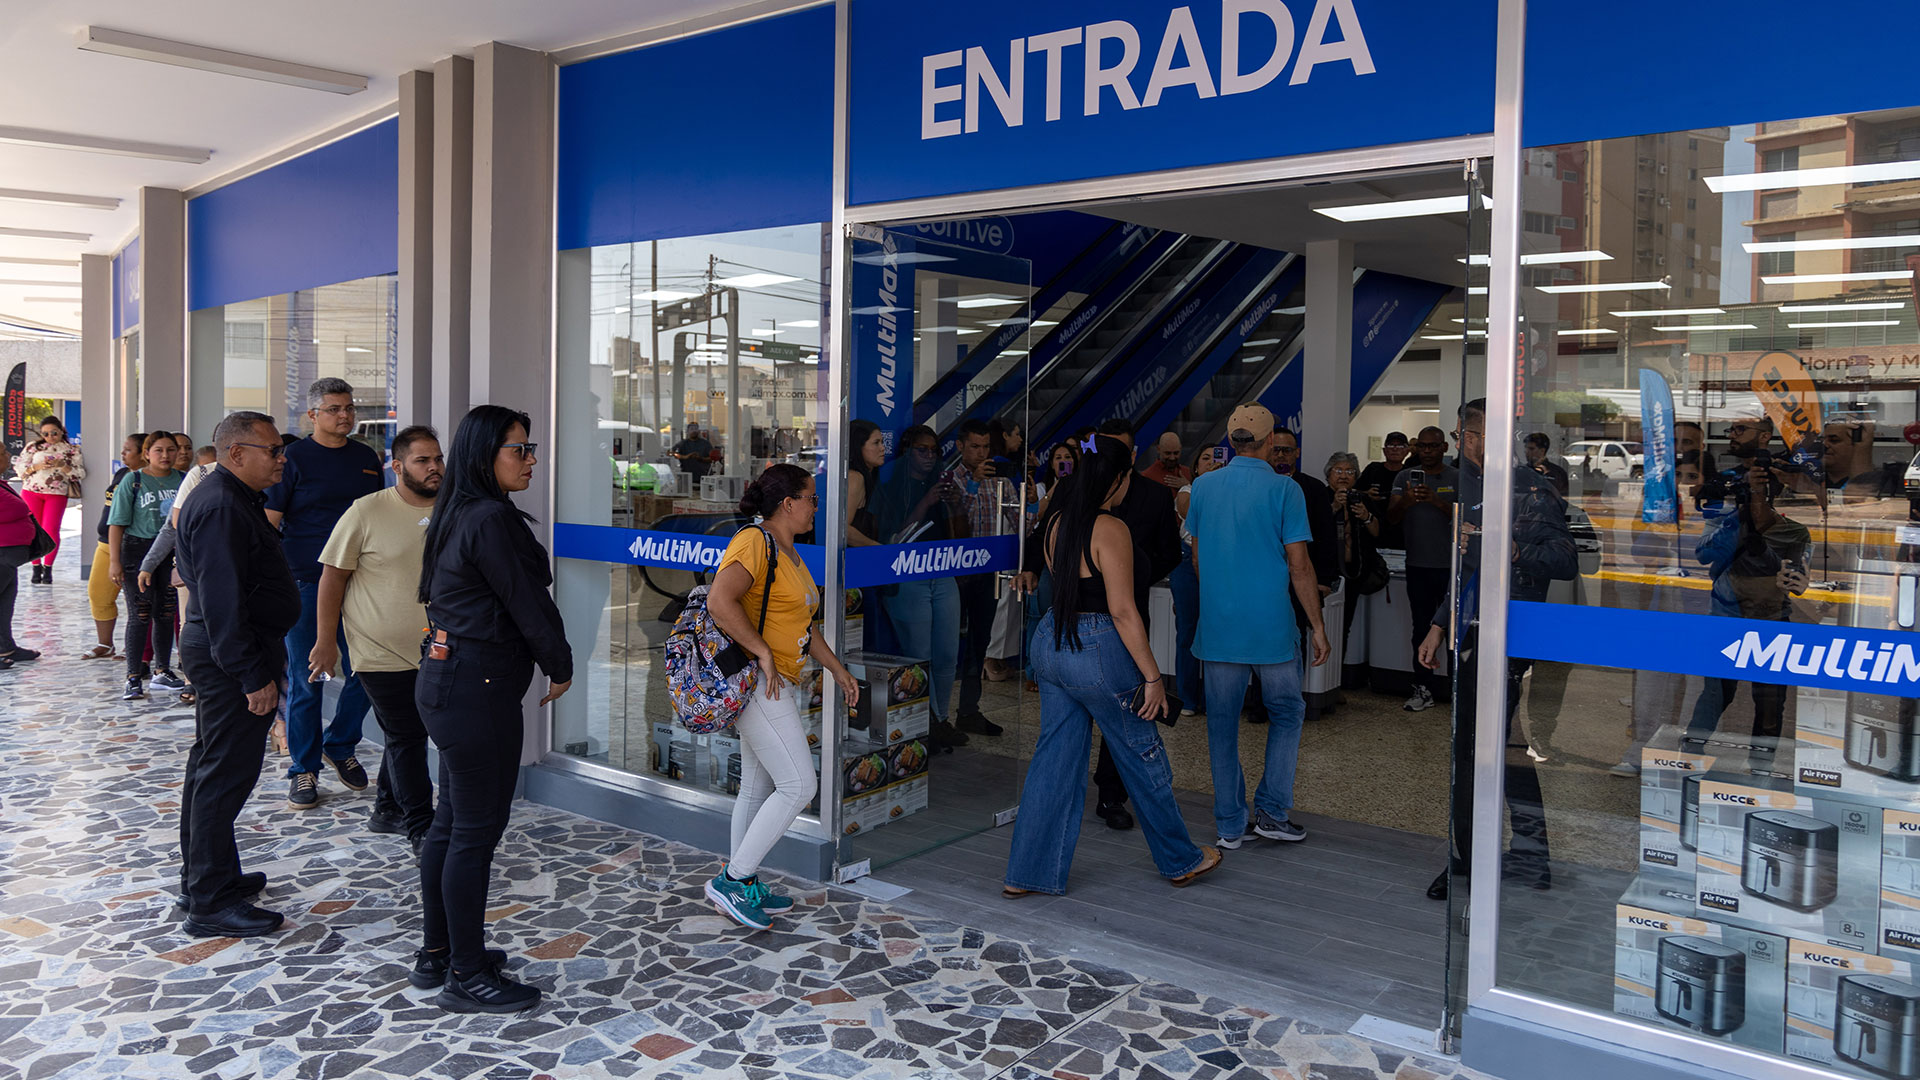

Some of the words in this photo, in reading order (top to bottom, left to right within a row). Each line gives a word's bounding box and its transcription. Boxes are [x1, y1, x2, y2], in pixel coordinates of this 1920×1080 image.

[921, 0, 1376, 140] ENTRADA
[1163, 300, 1198, 338] MultiMax
[1240, 295, 1275, 336] MultiMax
[877, 251, 898, 409] MultiMax
[1059, 306, 1095, 344] MultiMax
[1800, 357, 1875, 370] Horns
[1882, 357, 1895, 374] y
[1101, 370, 1163, 423] ultiMax
[140, 492, 156, 508] LOS
[633, 536, 726, 566] MultiMax
[896, 546, 983, 575] MultiMax
[1735, 631, 1920, 684] MultiM
[1654, 758, 1692, 770] KUCCE
[1816, 772, 1838, 780] Fryer
[1713, 792, 1755, 806] KUCCE
[1899, 821, 1920, 831] KU
[1657, 852, 1675, 860] Fryer
[1715, 896, 1736, 905] Fryer
[1628, 915, 1668, 930] KUCCE
[1843, 923, 1852, 933] 8
[1889, 931, 1902, 939] Air
[1903, 933, 1920, 944] Frye
[1804, 952, 1849, 968] KUCCE
